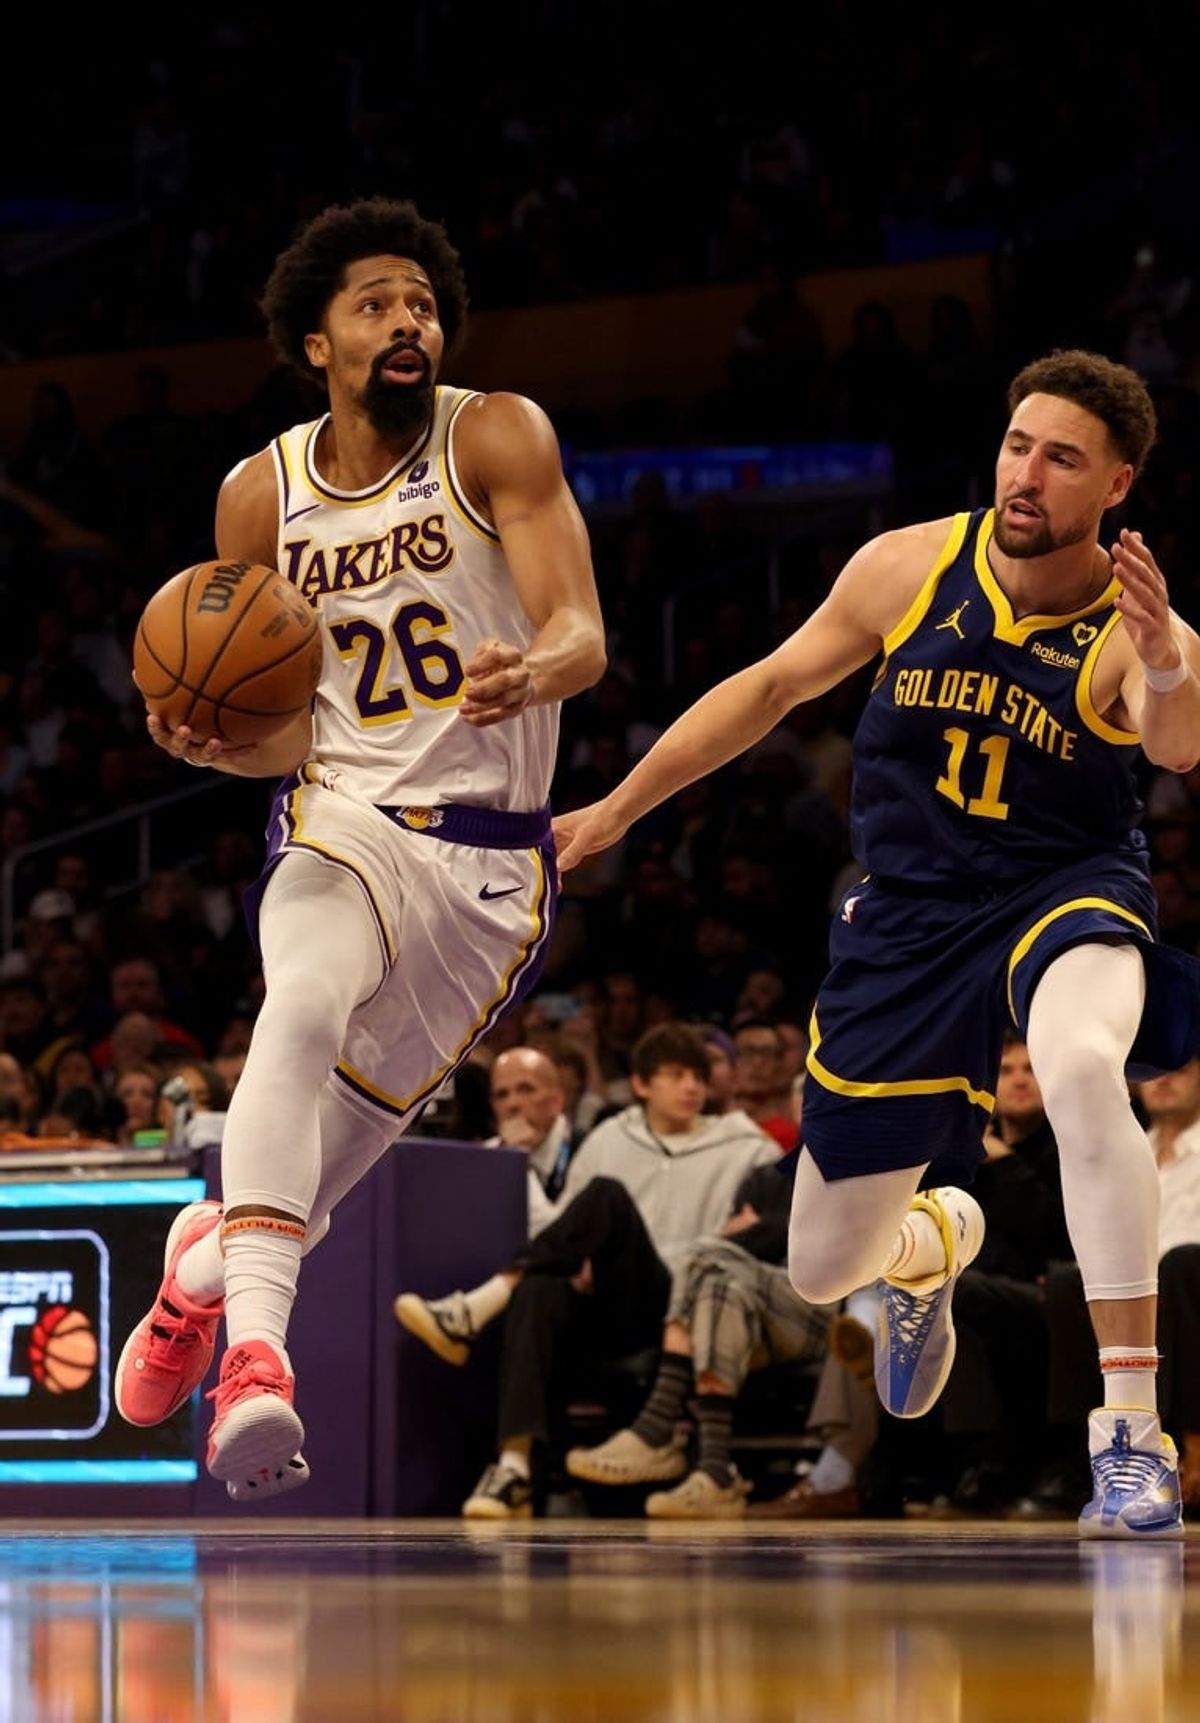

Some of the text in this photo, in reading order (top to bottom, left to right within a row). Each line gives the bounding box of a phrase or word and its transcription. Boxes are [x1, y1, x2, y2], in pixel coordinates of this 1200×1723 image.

[398, 480, 440, 502] bibigo
[284, 514, 455, 608] LAKERS
[326, 600, 468, 729] 26
[1030, 641, 1081, 670] Rakuten
[894, 668, 1078, 762] GOLDEN STATE
[935, 726, 1011, 821] 11
